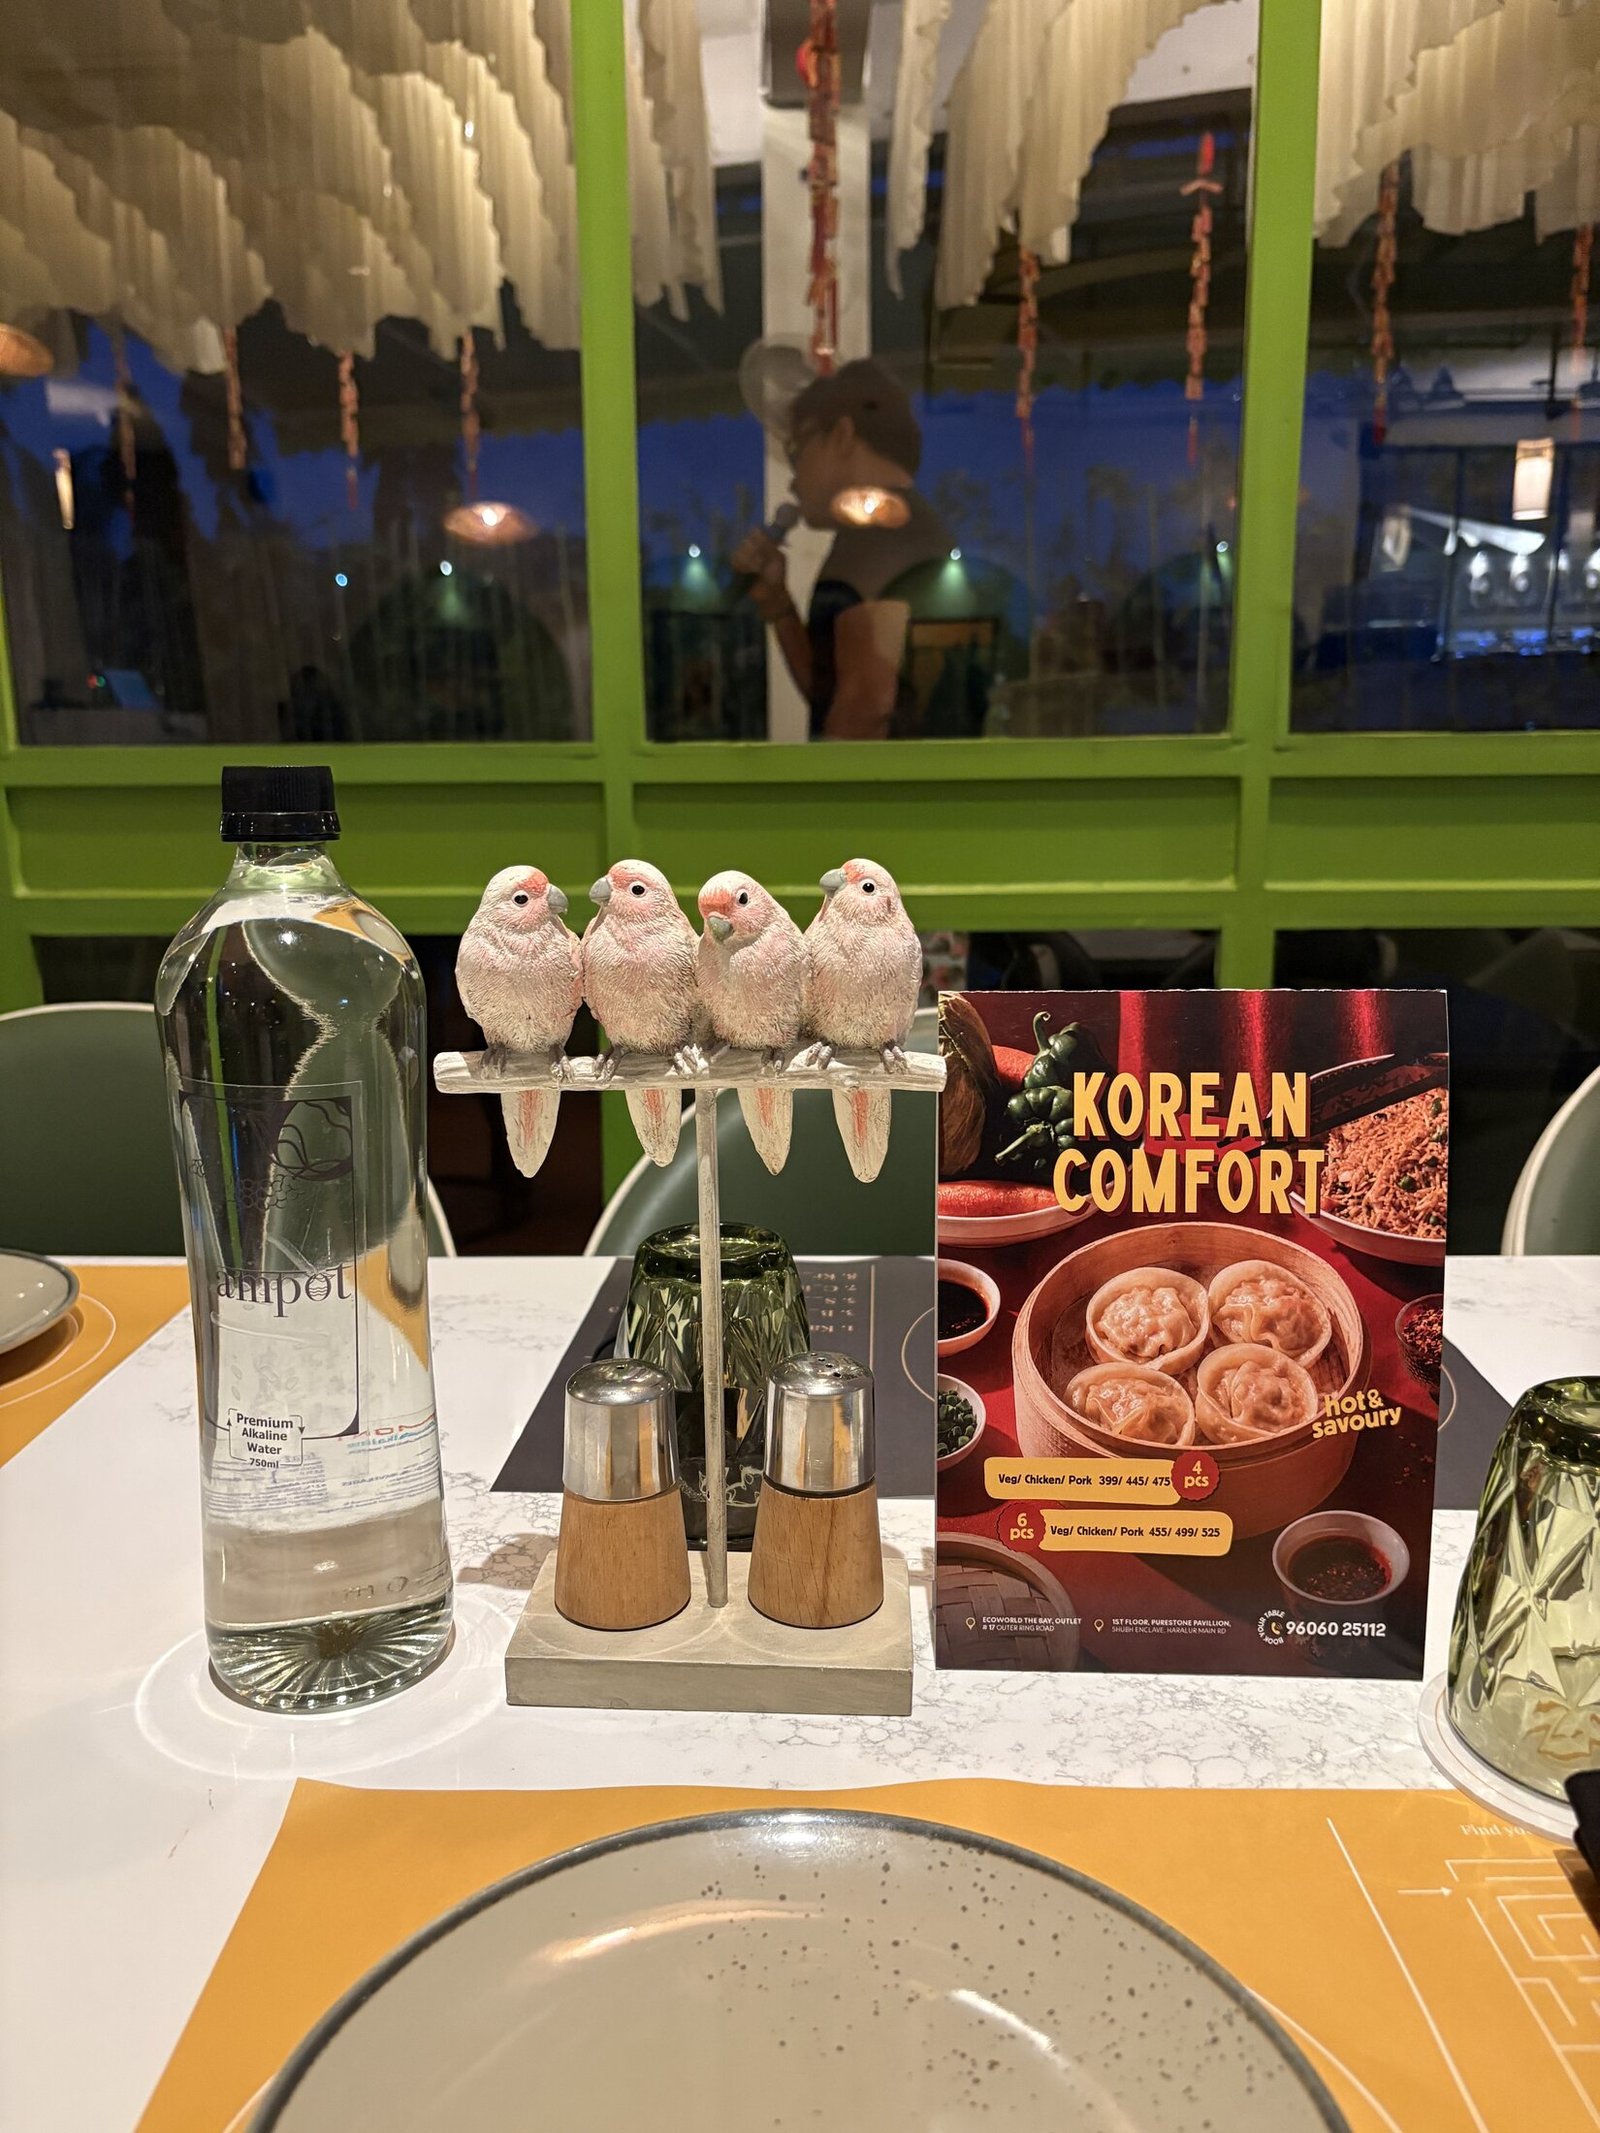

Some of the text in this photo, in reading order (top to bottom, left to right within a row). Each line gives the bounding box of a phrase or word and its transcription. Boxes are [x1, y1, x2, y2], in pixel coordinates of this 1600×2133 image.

[1073, 1072, 1307, 1138] KOREAN
[1053, 1148, 1328, 1214] COMFORT
[236, 1413, 294, 1428] Premium
[1312, 1406, 1402, 1439] savoury
[242, 1427, 287, 1440] Alkaline
[247, 1442, 282, 1454] Water
[249, 1458, 279, 1468] 750ml
[1192, 1460, 1202, 1475] 4
[998, 1473, 1171, 1486] Veg/ Chicken/ Pork 399/ 445/ 475
[1184, 1474, 1209, 1488] pcs
[1017, 1512, 1028, 1527] 6
[1010, 1526, 1034, 1541] pcs
[1050, 1525, 1220, 1537] Veg/ Chicken/ Pork 455/ 499/ 525
[982, 1616, 1023, 1624] ECOWORLD
[1055, 1617, 1082, 1625] OUTLET
[1263, 1609, 1285, 1619] TABLE
[1285, 1621, 1387, 1637] 96060 25112
[1460, 1824, 1502, 1836] Find
